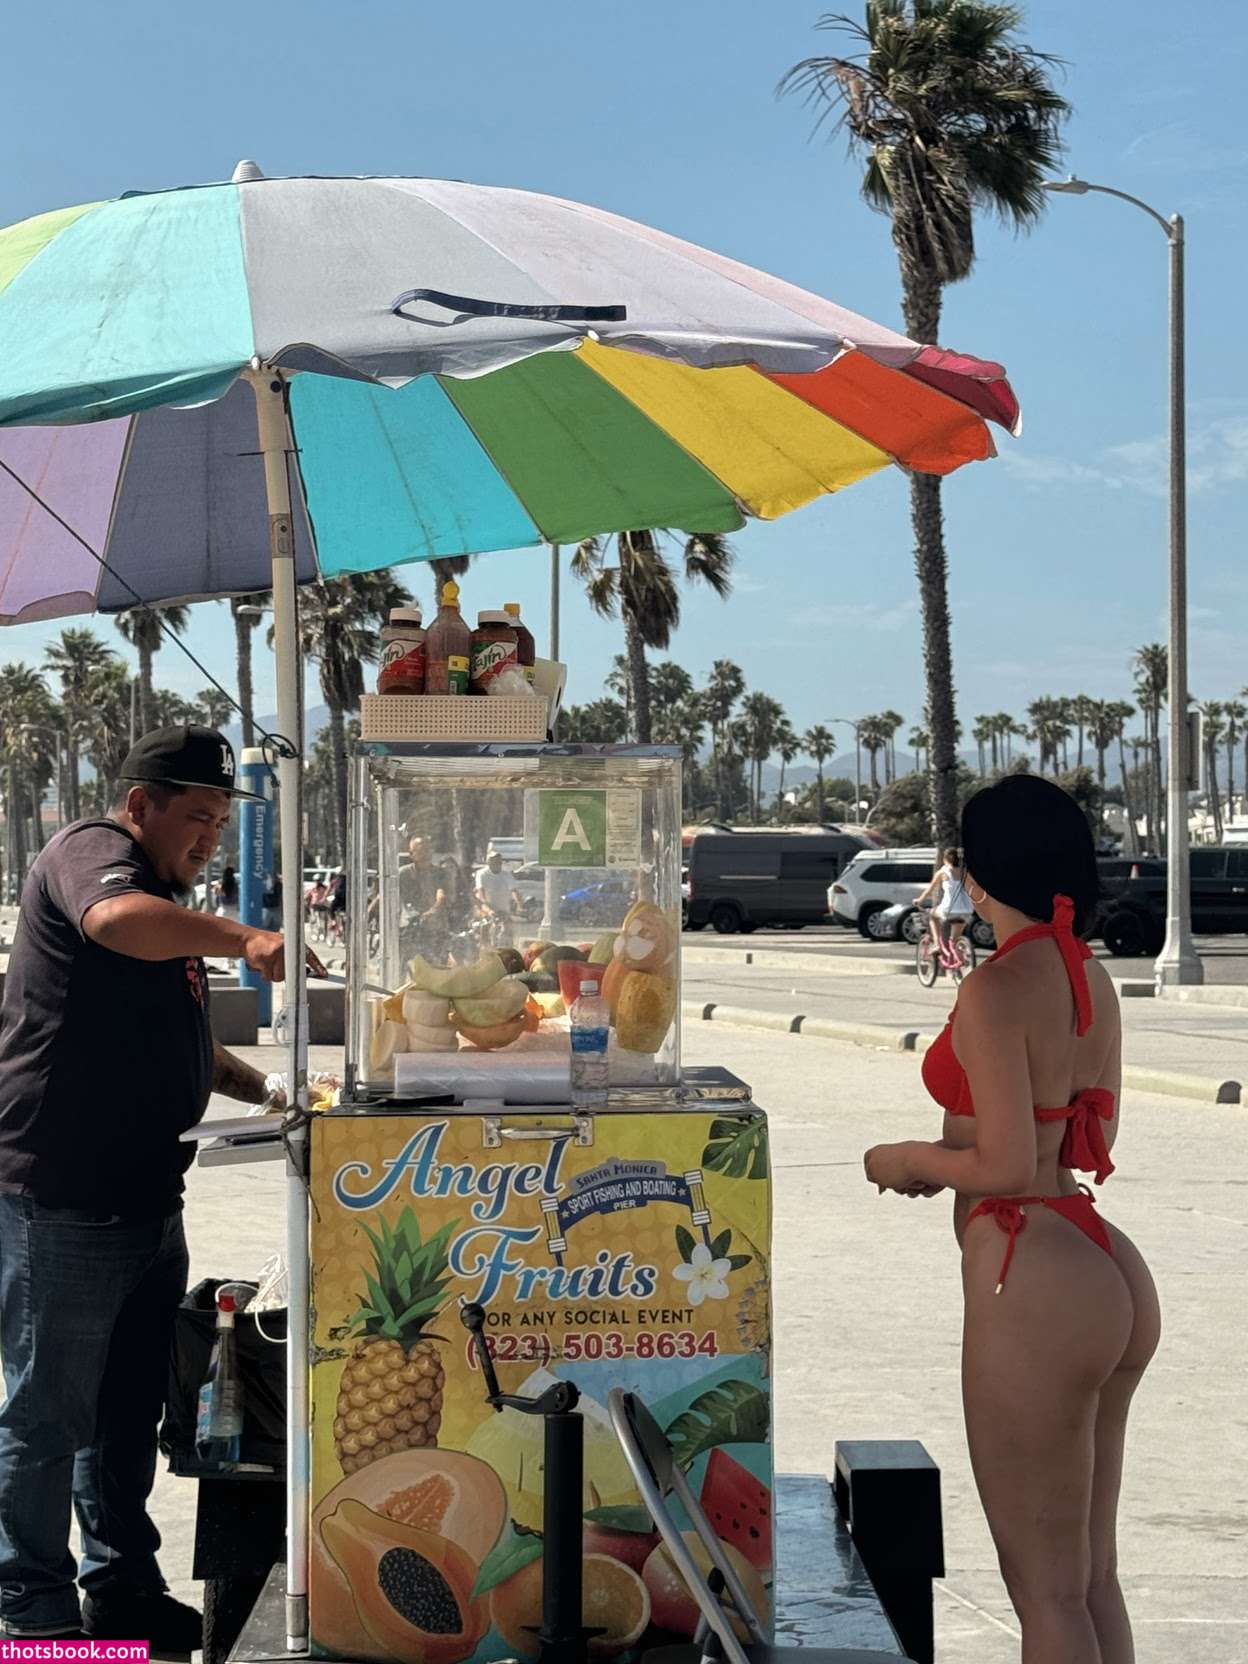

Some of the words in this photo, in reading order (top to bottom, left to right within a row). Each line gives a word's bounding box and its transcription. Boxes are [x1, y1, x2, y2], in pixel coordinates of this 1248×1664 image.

[220, 744, 234, 776] LA
[253, 805, 266, 878] Emergency
[551, 808, 592, 850] A
[333, 1120, 570, 1221] Angel
[568, 1192, 594, 1214] SPORT
[593, 1184, 625, 1205] FISHING
[625, 1181, 642, 1196] AND
[643, 1180, 676, 1196] BOATING
[613, 1199, 636, 1210] PIER
[449, 1226, 658, 1306] Fruits
[487, 1312, 511, 1327] OR
[520, 1311, 556, 1325] ANY
[564, 1310, 630, 1325] SOCIAL
[638, 1308, 694, 1324] EVENT
[562, 1330, 719, 1360] 503-8634
